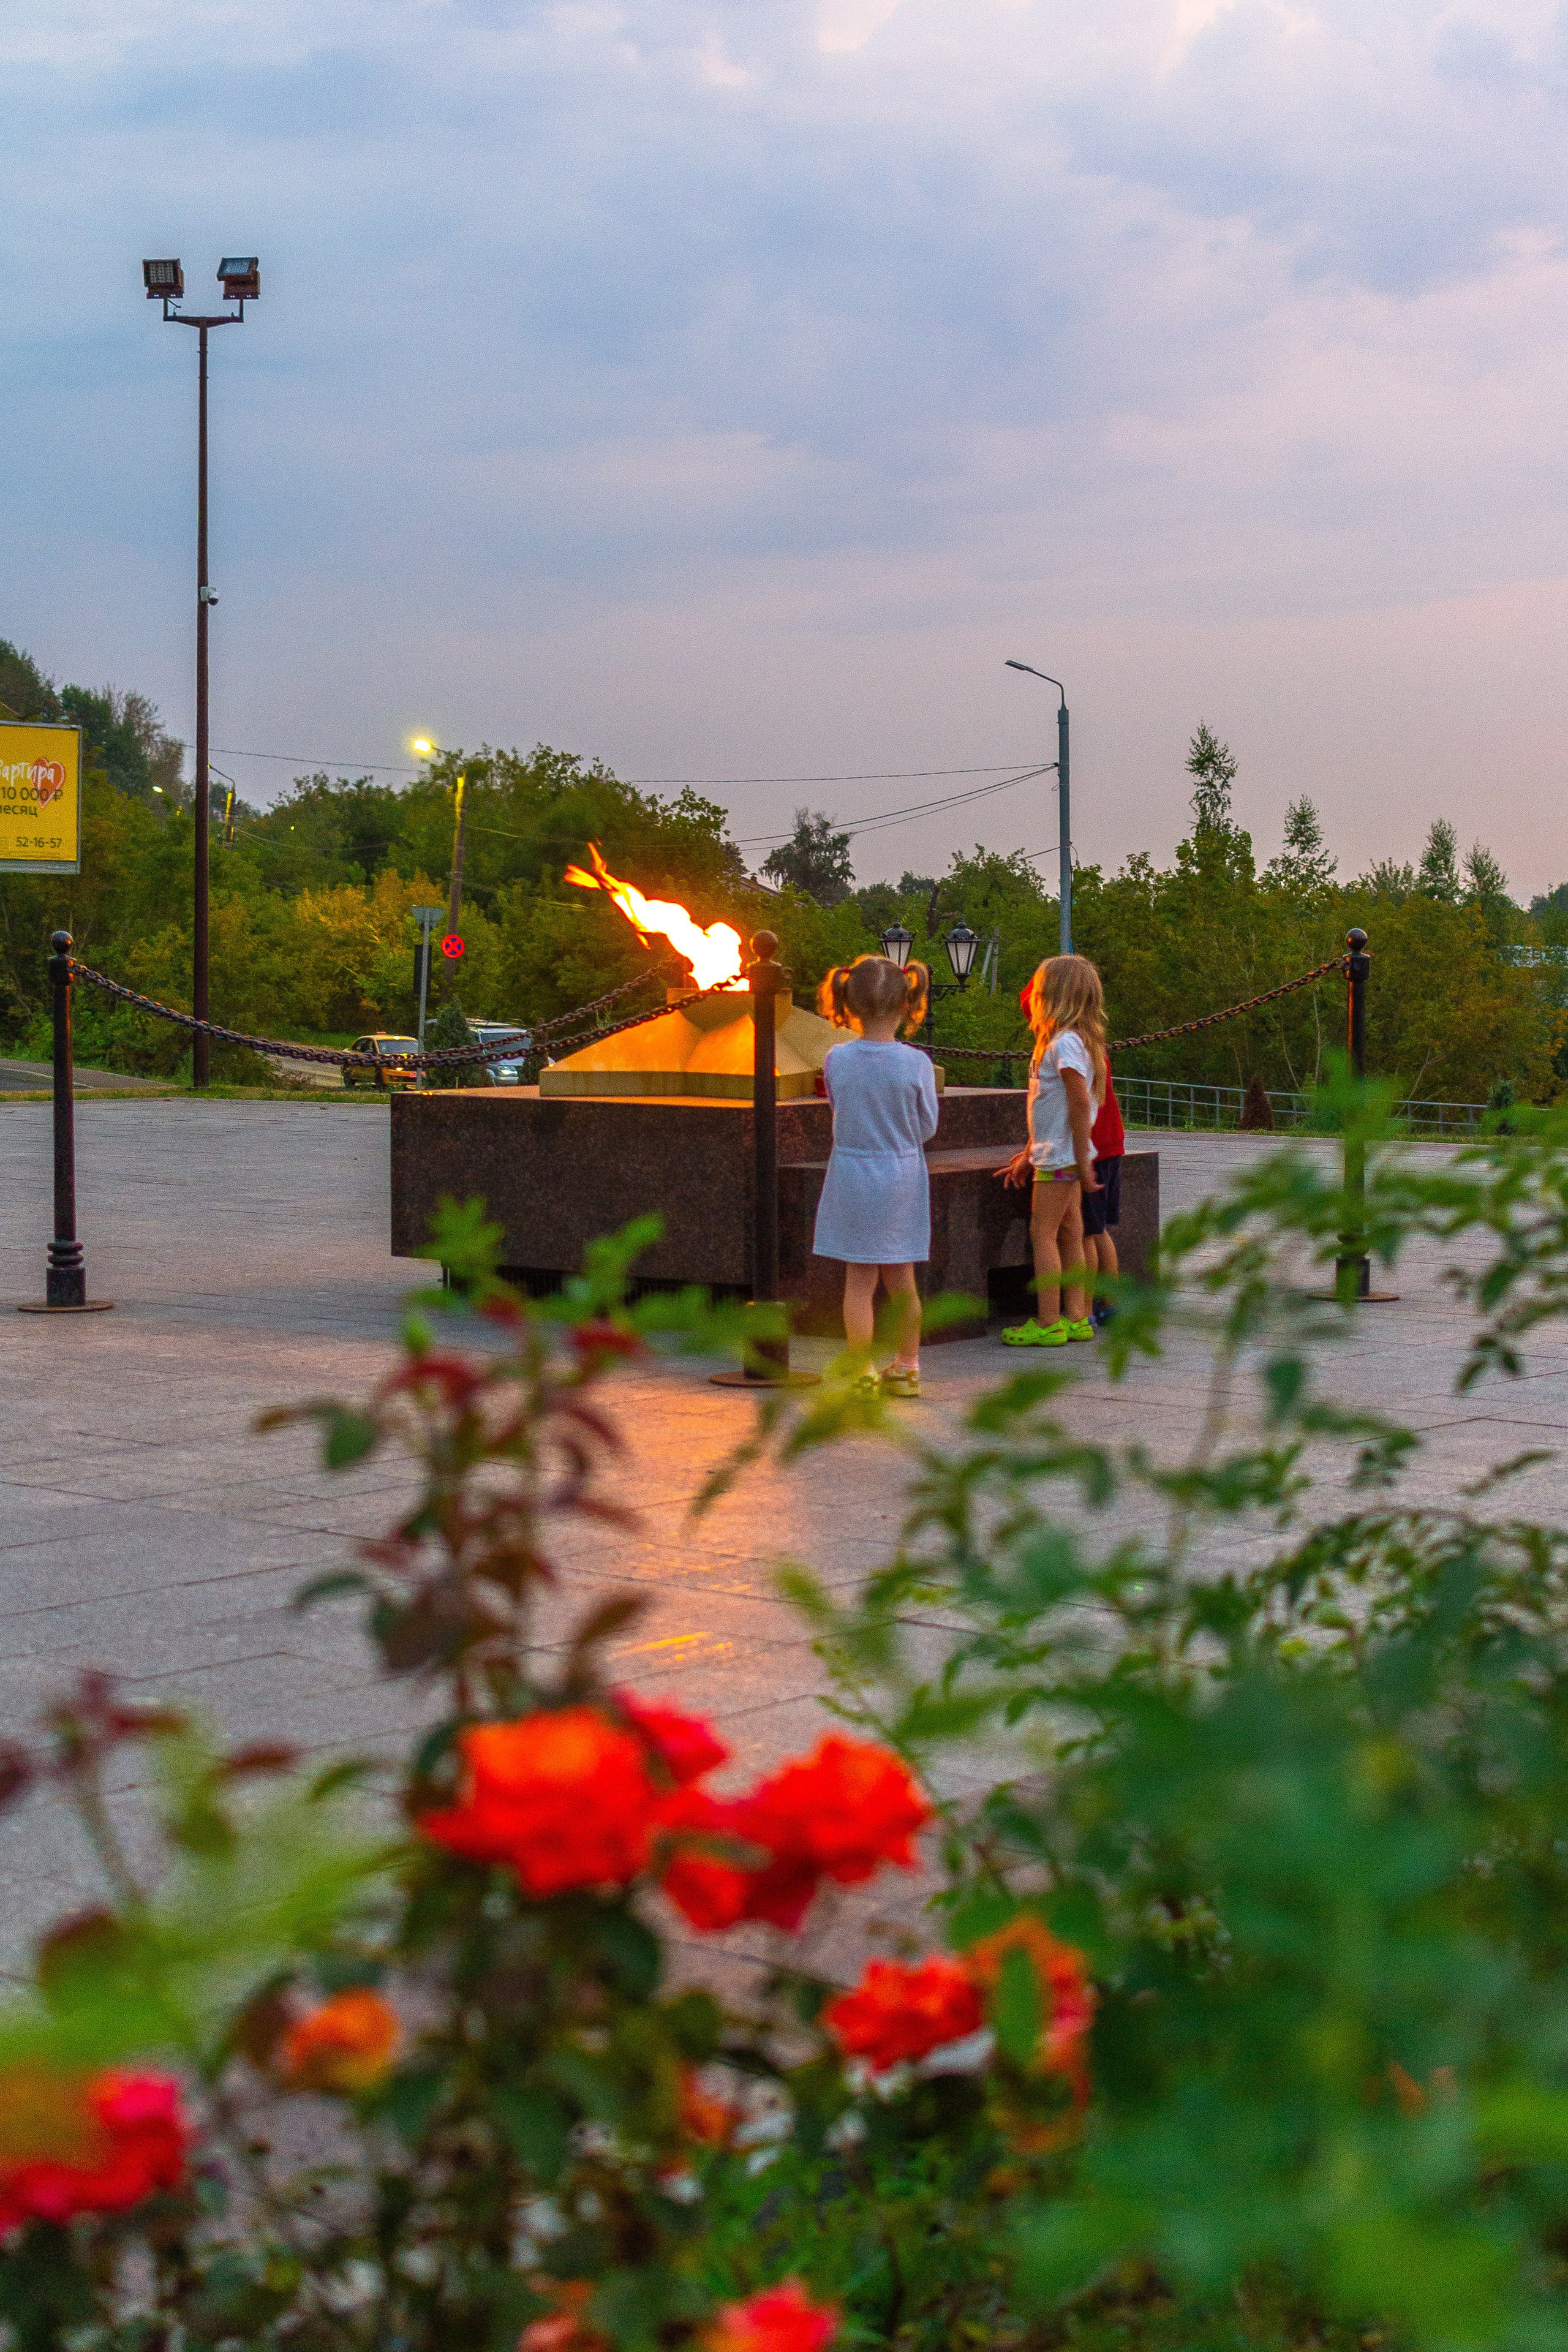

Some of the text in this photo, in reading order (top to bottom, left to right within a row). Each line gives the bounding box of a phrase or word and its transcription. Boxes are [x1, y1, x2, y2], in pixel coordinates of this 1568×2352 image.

[2, 786, 17, 800] 10
[20, 787, 49, 801] 000
[16, 836, 62, 848] 52-16-57
